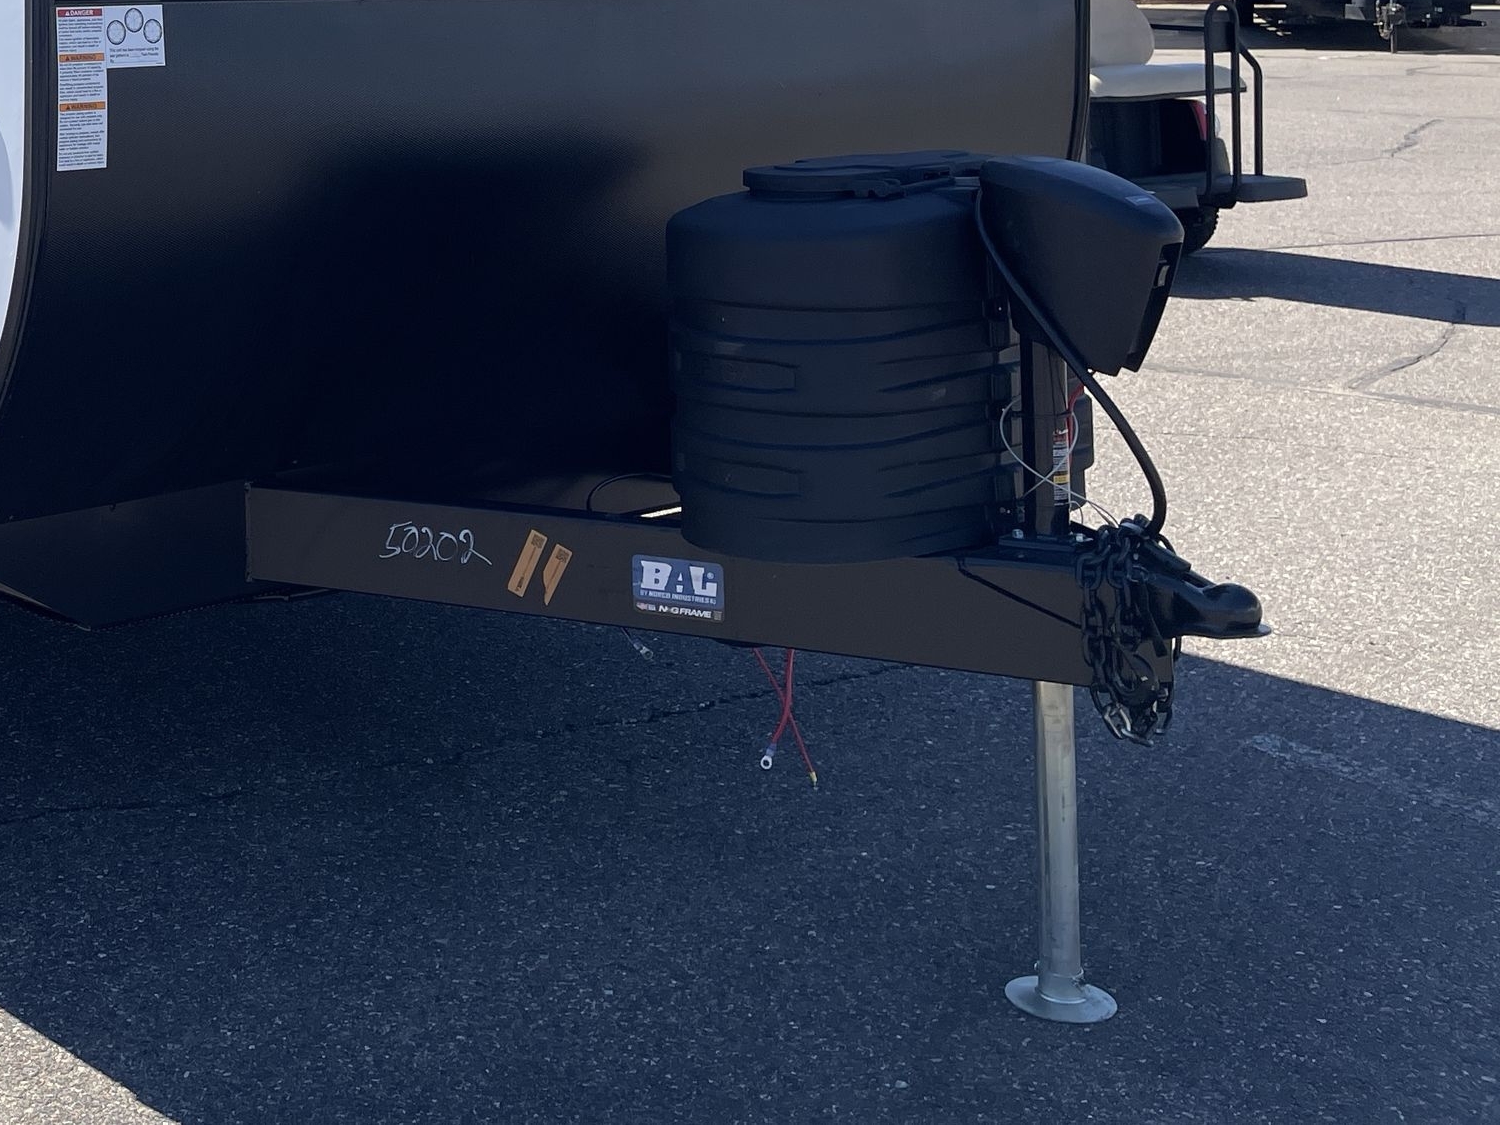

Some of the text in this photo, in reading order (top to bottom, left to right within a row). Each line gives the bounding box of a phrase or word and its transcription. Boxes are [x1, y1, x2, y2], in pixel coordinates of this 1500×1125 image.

[70, 9, 94, 17] DANGER
[379, 521, 492, 565] 50202
[640, 560, 718, 597] BAL
[680, 607, 712, 619] FRAME
